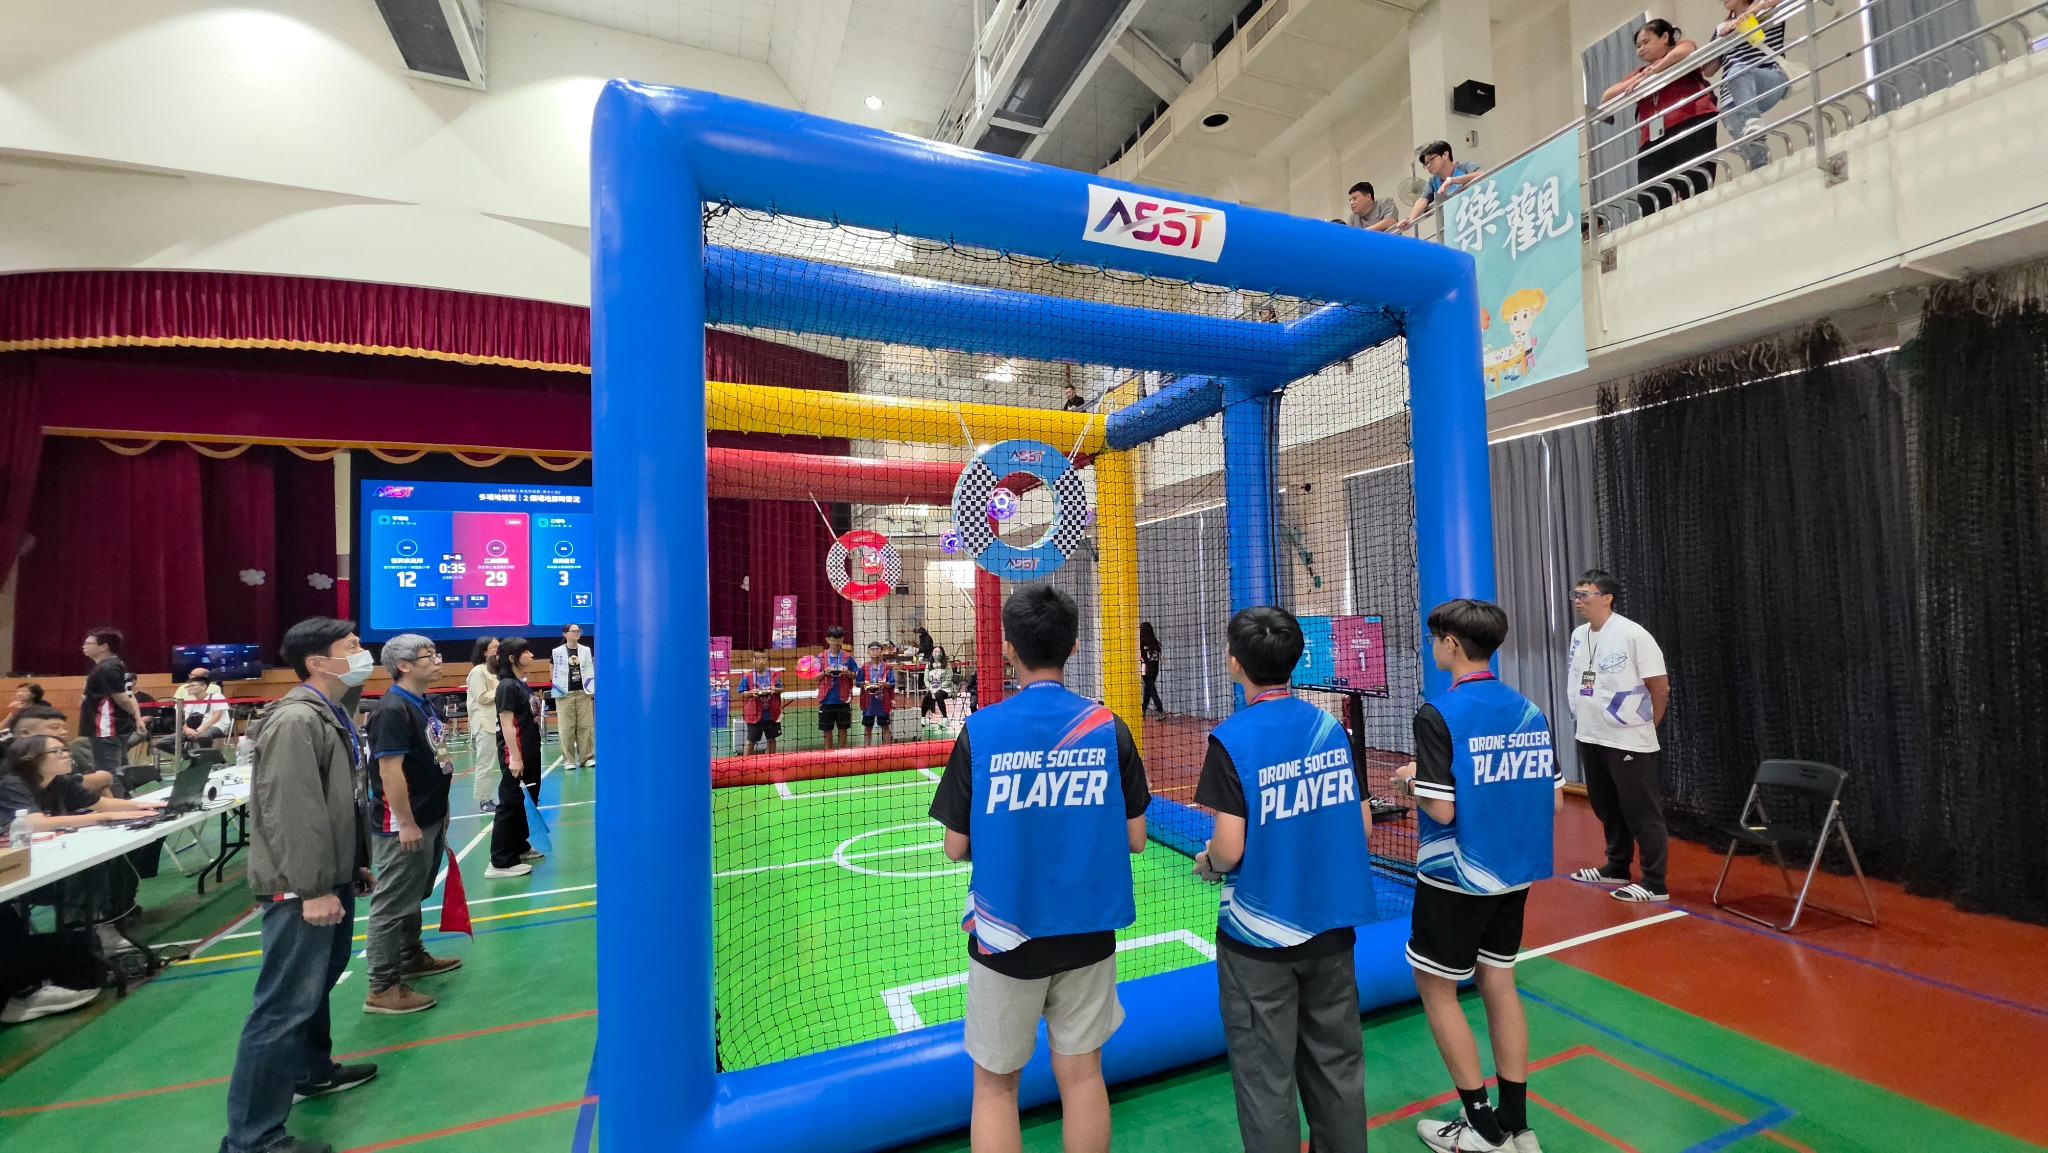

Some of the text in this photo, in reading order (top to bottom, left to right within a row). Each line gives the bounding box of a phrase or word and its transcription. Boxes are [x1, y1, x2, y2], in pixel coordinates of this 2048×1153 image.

[1093, 196, 1213, 250] ASST
[1453, 175, 1575, 260] 樂觀
[1009, 449, 1045, 463] ASST
[373, 486, 414, 498] ASST
[438, 563, 467, 574] 0:35
[1004, 557, 1040, 571] ASST
[396, 571, 417, 588] 12
[485, 570, 509, 587] 29
[558, 570, 569, 587] 3
[1468, 730, 1551, 753] DRONE SOCCER
[989, 748, 1107, 773] DRONE SOCCER
[1258, 747, 1349, 787] DRONE SOCCER
[1471, 748, 1554, 786] PLAYER
[985, 769, 1109, 815] PLAYER
[1260, 767, 1355, 826] PLAYER
